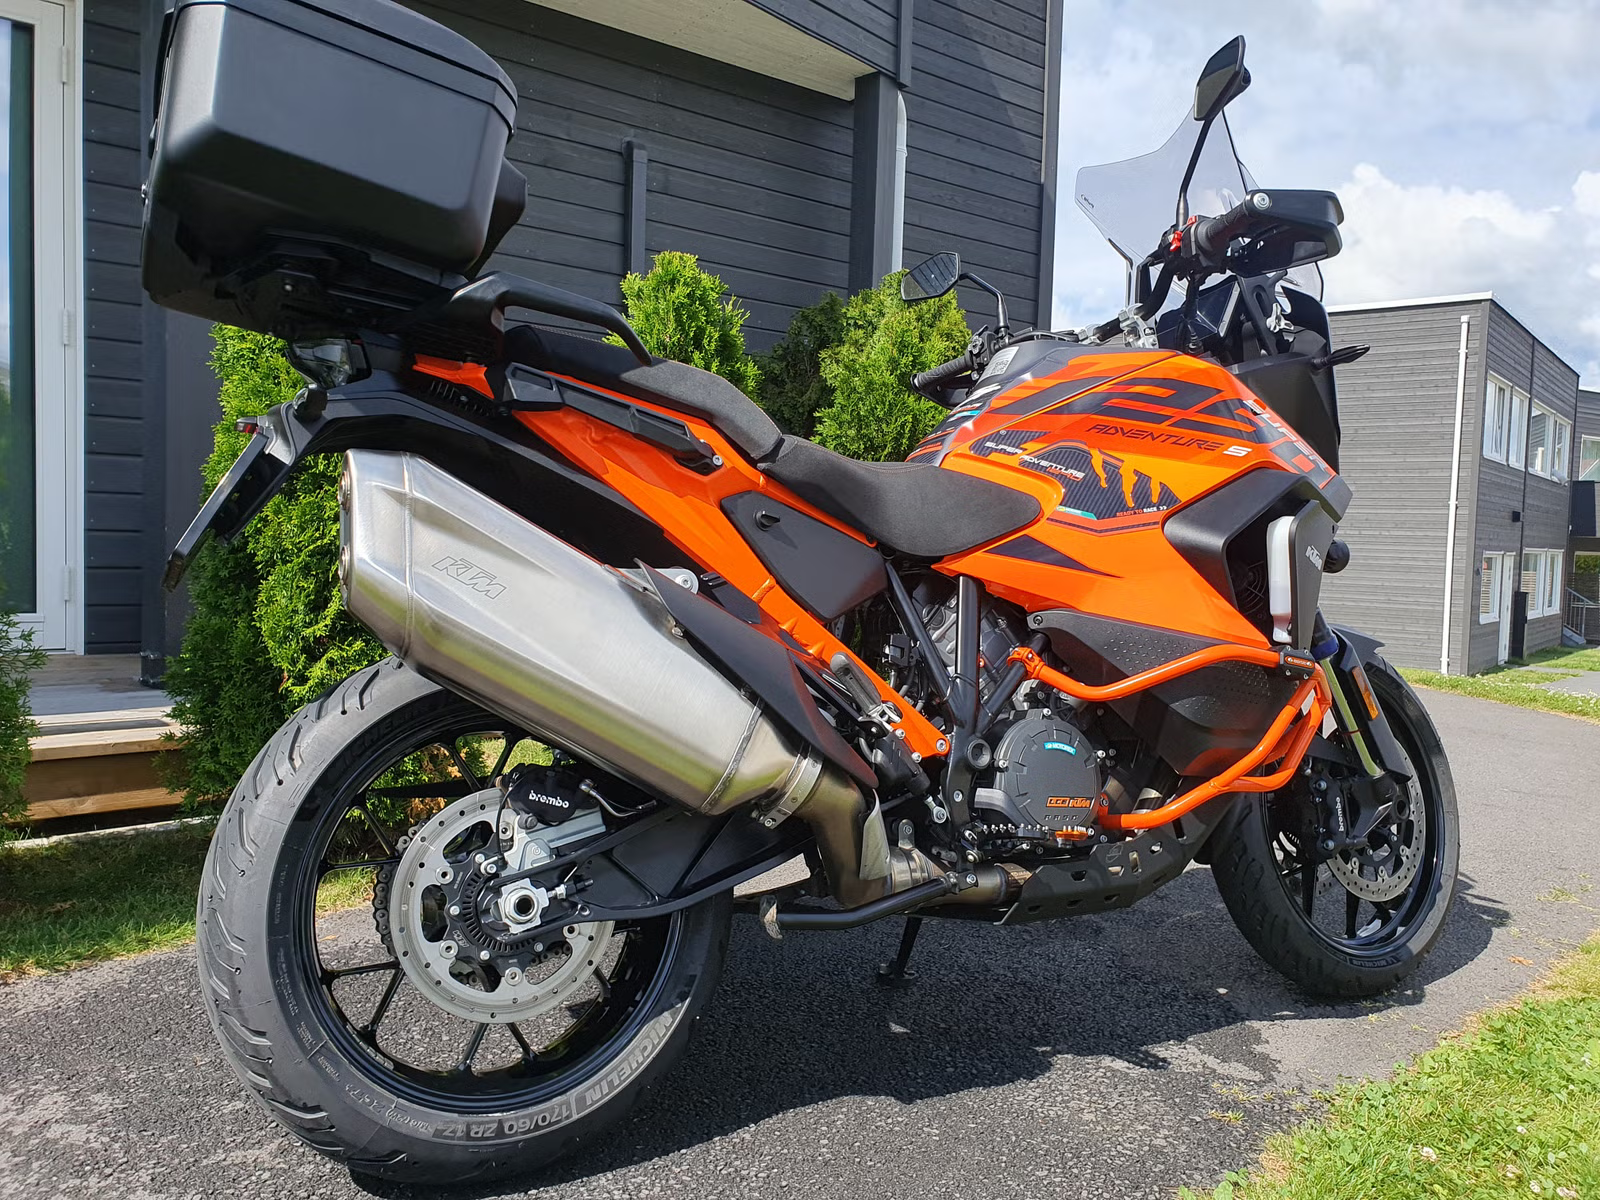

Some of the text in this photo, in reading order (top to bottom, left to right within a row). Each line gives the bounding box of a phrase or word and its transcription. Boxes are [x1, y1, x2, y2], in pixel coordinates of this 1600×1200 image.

[985, 441, 1023, 454] SUPER
[1086, 424, 1253, 457] ADVENTURE S
[1243, 399, 1328, 472] SUPER
[1020, 455, 1085, 477] ADVENTURE
[1305, 545, 1323, 570] KTM
[431, 555, 507, 600] KTM
[528, 790, 569, 808] brembo
[1069, 797, 1090, 807] KTM
[1335, 796, 1345, 832] brembo
[586, 1012, 676, 1106] MICHELIN
[470, 1122, 497, 1138] ZR
[504, 1104, 569, 1134] 170/60
